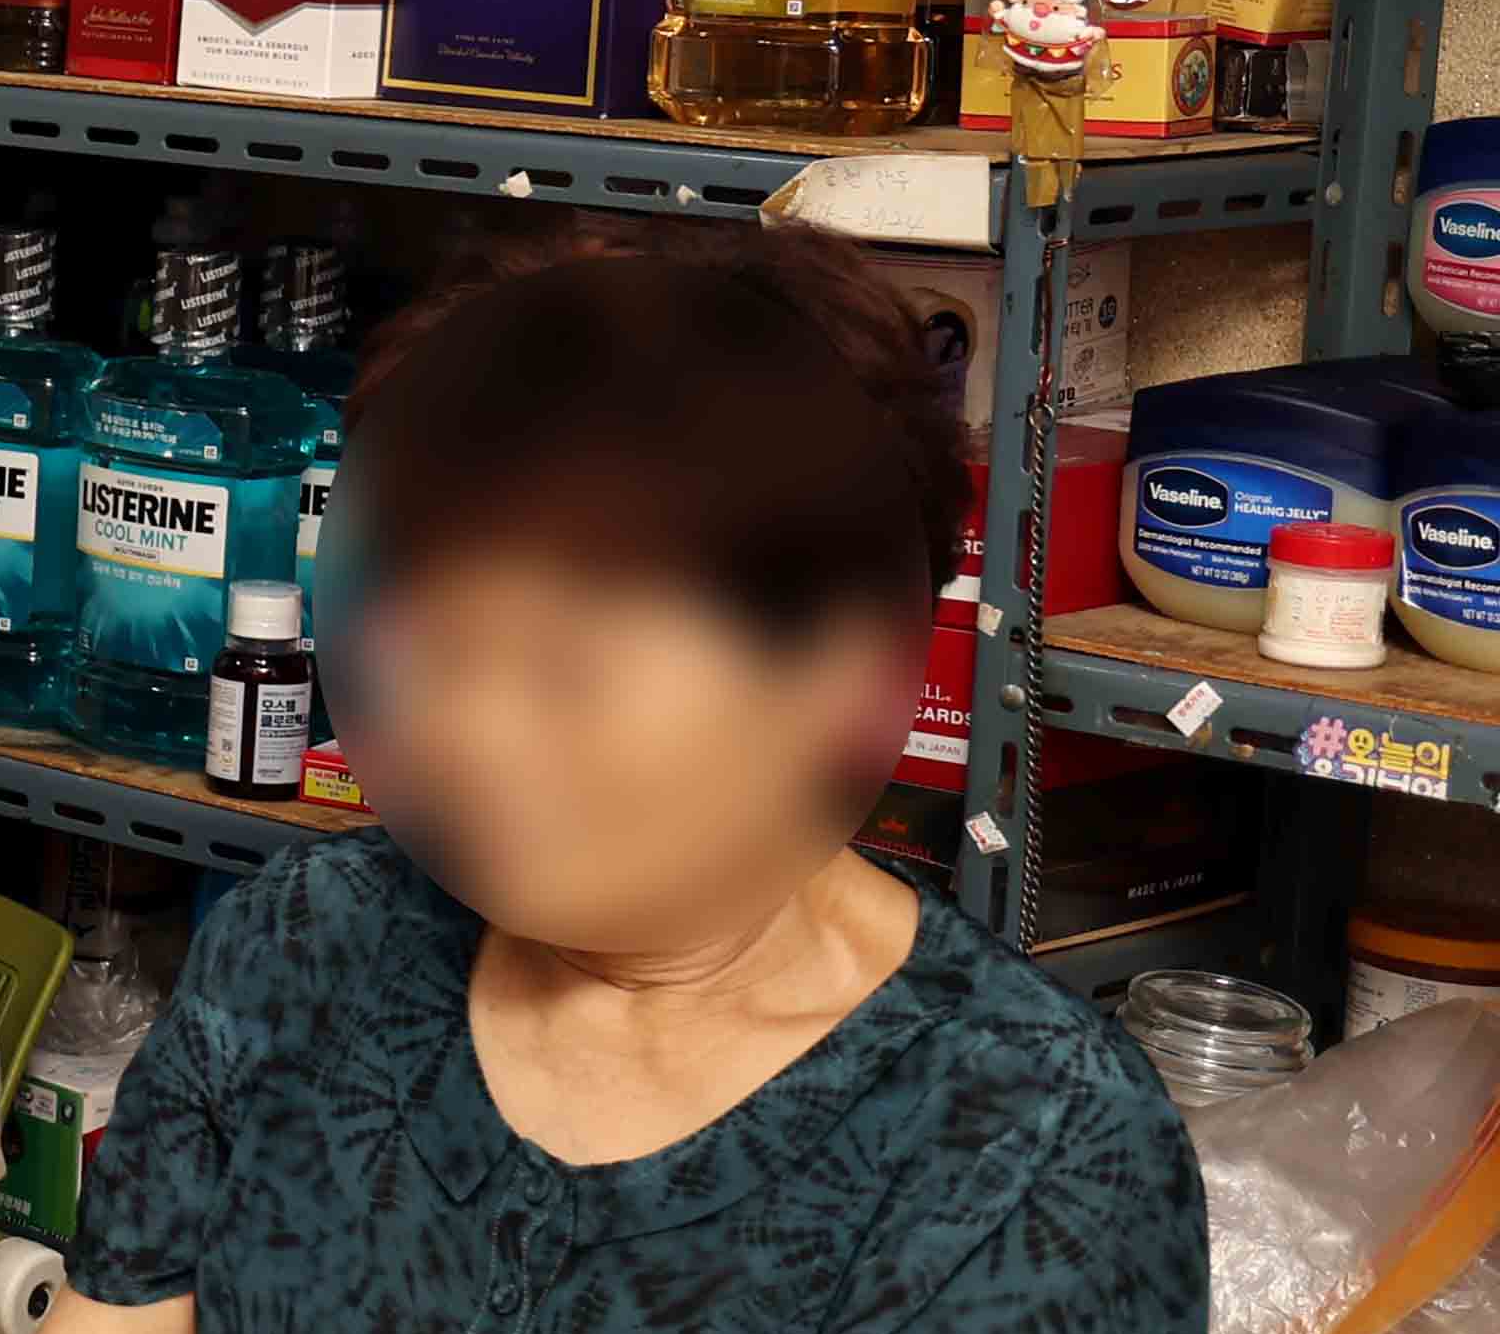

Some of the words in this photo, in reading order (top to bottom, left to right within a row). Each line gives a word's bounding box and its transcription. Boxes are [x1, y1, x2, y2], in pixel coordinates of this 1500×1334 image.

[180, 287, 230, 310] LISTERINE
[82, 478, 218, 535] LISTERINE
[1234, 503, 1285, 518] HEALING
[95, 519, 136, 544] COOL
[139, 526, 189, 552] MINT
[1138, 529, 1193, 547] Dermatologist
[1193, 537, 1262, 555] Recommended
[1405, 570, 1462, 591] Dermatologist
